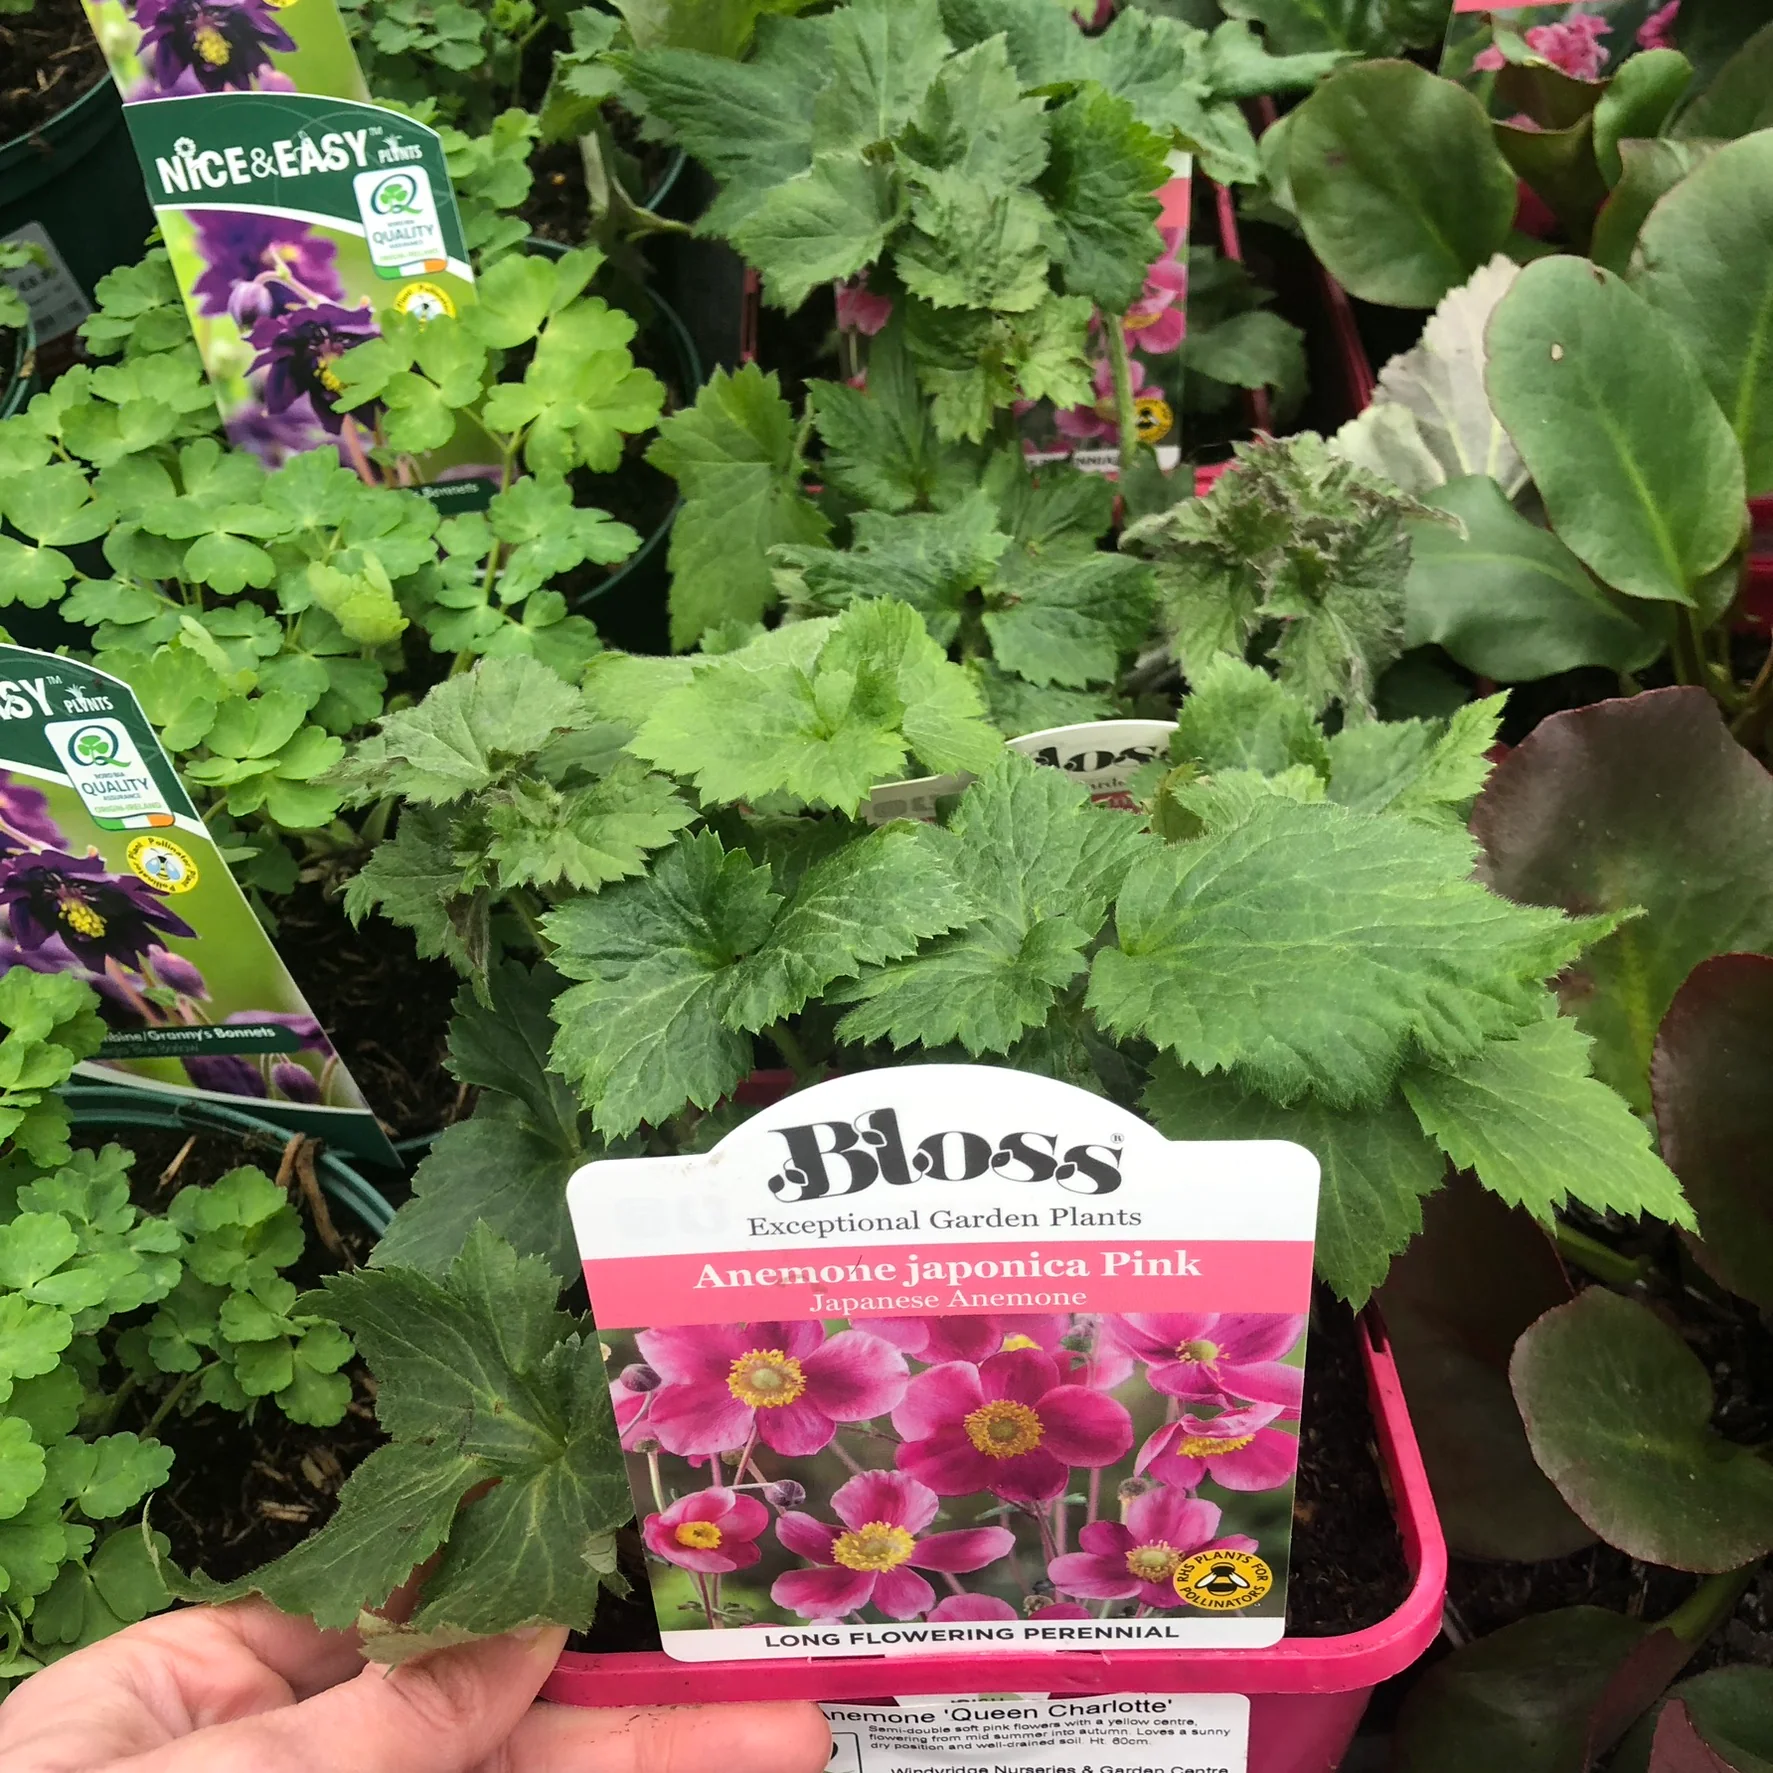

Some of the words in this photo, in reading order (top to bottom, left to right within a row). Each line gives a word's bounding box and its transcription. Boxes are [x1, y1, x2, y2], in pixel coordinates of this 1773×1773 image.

[372, 224, 434, 245] QUALITY
[81, 778, 149, 797] QUALITY
[214, 1026, 276, 1038] Bonnets
[767, 1107, 1124, 1203] Bloss
[747, 1210, 920, 1238] Exceptional
[930, 1207, 1039, 1230] Garden
[1049, 1206, 1142, 1227] Plants
[693, 1263, 897, 1289] Anemone
[902, 1251, 1091, 1287] japonica
[1099, 1249, 1204, 1277] Pink
[809, 1292, 940, 1315] Japanese
[946, 1288, 1087, 1308] Anemone
[1177, 1563, 1195, 1582] RHS
[1194, 1551, 1253, 1564] PLANTS
[1251, 1563, 1269, 1581] FOR
[1179, 1585, 1265, 1608] POLLINATORS
[765, 1633, 840, 1648] LONG
[850, 1626, 1014, 1646] FLOWERING
[1024, 1625, 1180, 1641] PERENNIAL
[944, 1707, 1038, 1722] 'Queen
[1048, 1699, 1173, 1718] Charlotte'
[868, 1725, 951, 1735] Semi-double
[955, 1724, 979, 1732] soft
[983, 1723, 1010, 1732] pink
[1013, 1722, 1060, 1731] flowers
[1064, 1718, 1092, 1727] with
[1108, 1717, 1150, 1727] yellow
[869, 1733, 928, 1744] flowering
[994, 1731, 1048, 1739] summer
[1051, 1729, 1075, 1737] into
[1137, 1727, 1175, 1736] Loves
[1191, 1728, 1231, 1737] sunny
[870, 1742, 890, 1750] dry
[894, 1743, 944, 1751] position
[976, 1739, 1055, 1749] well-drained
